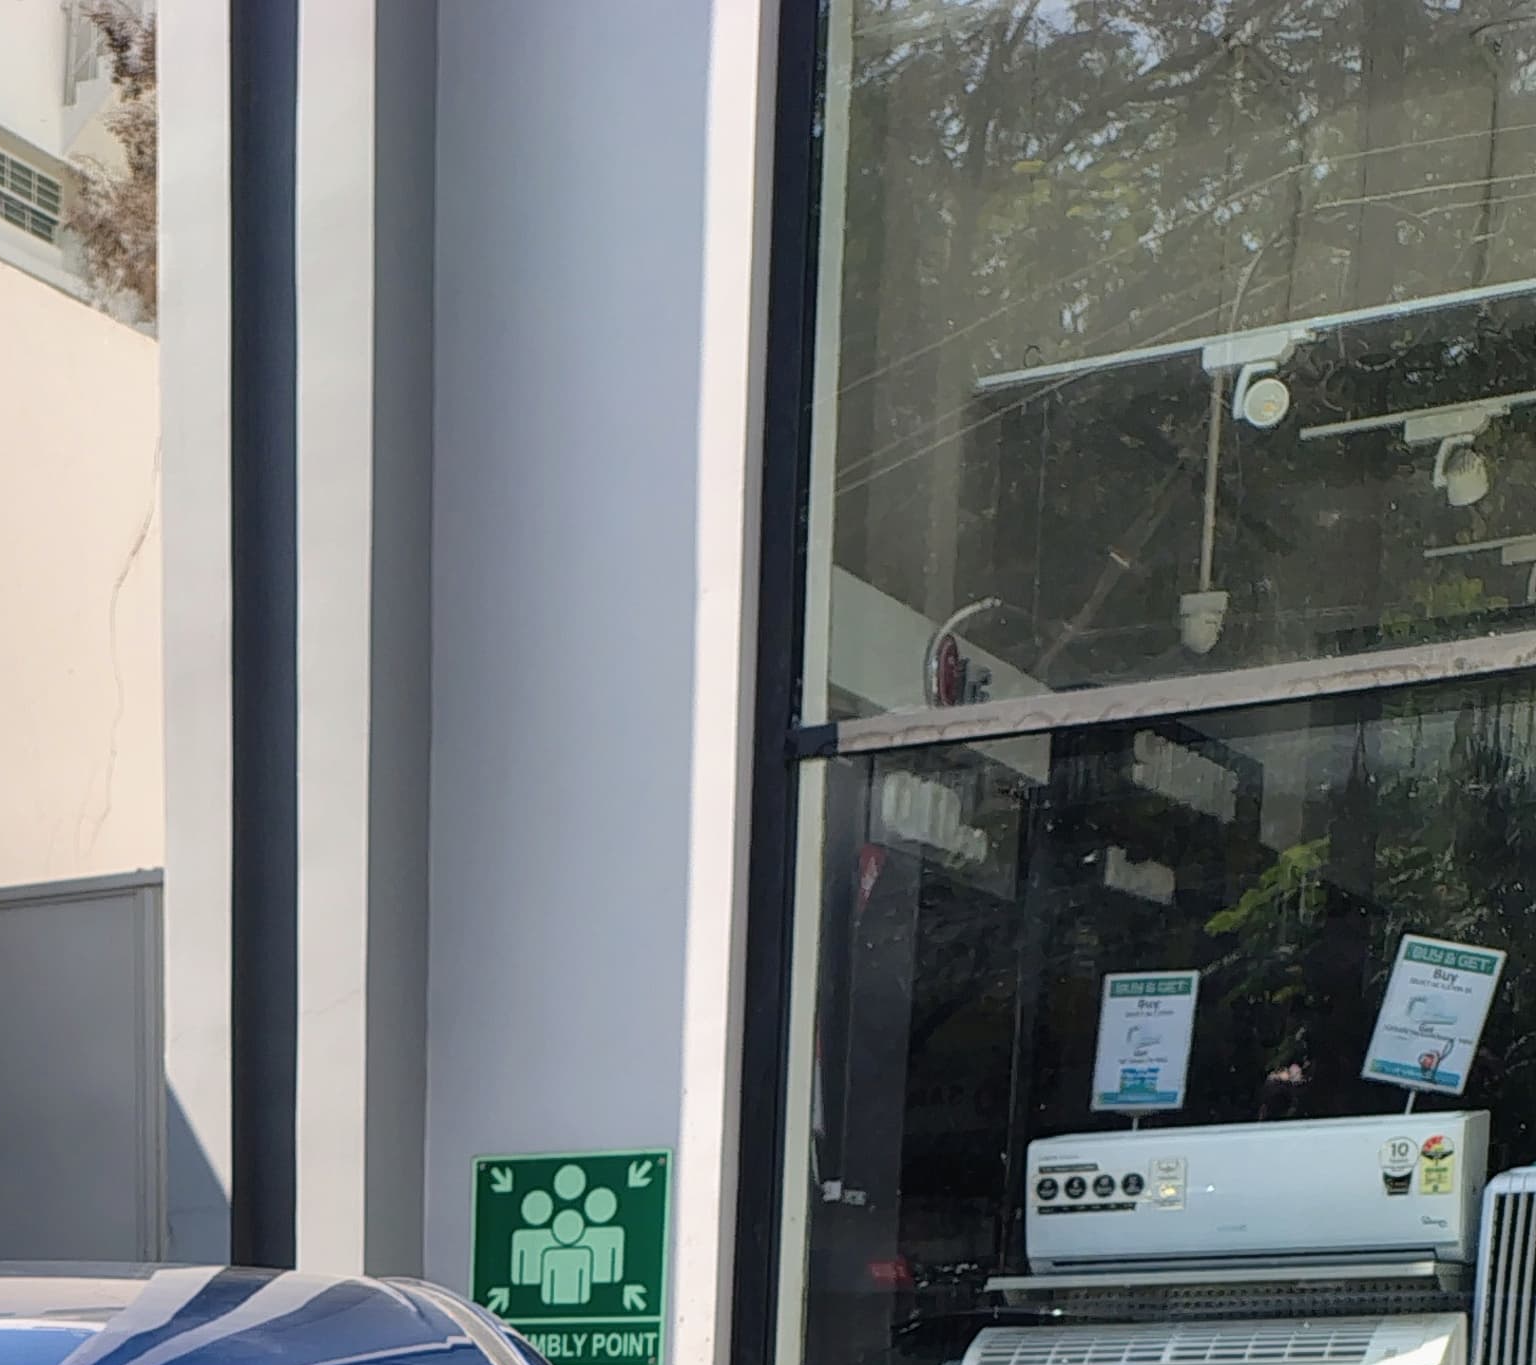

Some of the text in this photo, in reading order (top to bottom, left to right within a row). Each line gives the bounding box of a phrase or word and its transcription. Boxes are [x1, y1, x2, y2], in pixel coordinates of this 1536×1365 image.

[1457, 954, 1491, 971] GET
[1390, 1142, 1409, 1157] 10
[524, 1331, 658, 1357] MBLY POINT
